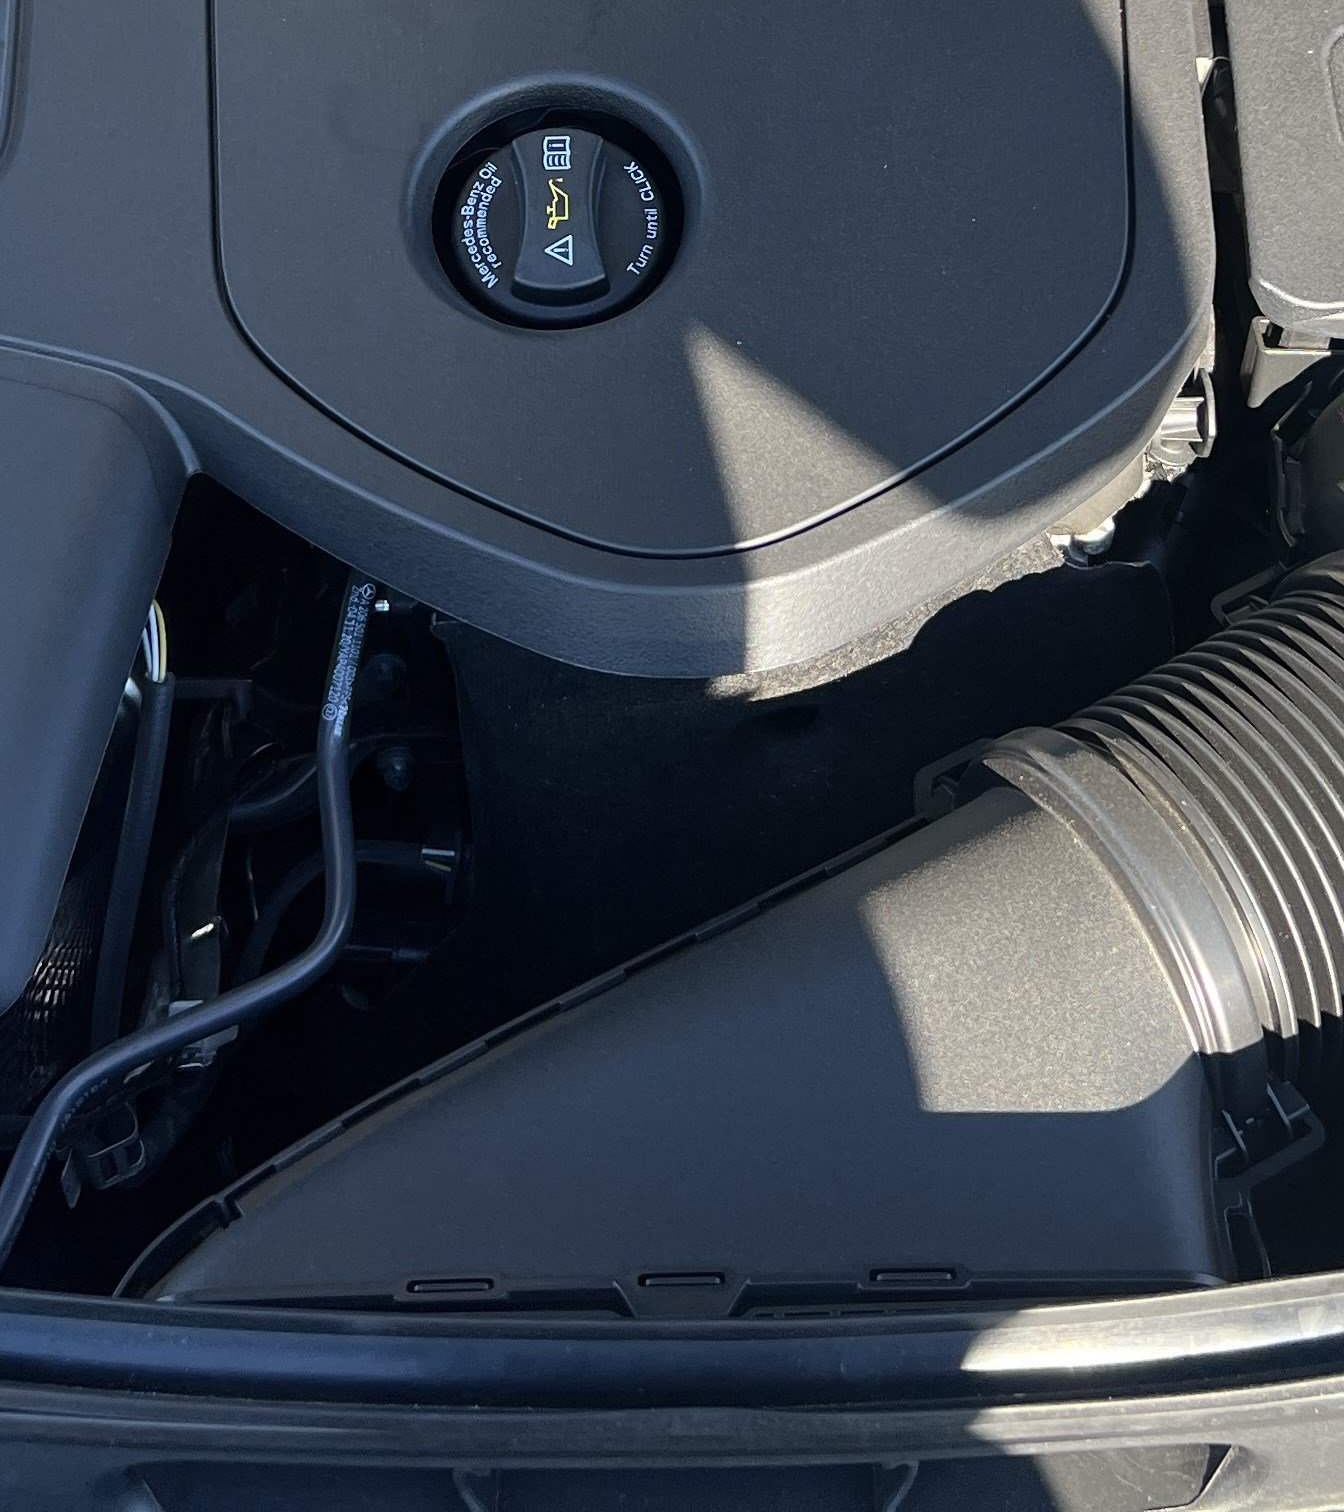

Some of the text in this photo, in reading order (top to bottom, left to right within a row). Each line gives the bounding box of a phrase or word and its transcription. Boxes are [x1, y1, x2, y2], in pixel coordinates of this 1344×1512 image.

[460, 161, 499, 288] Mercedes-Benz Oil
[476, 175, 503, 269] recommended
[623, 161, 658, 276] Turn until CLICK
